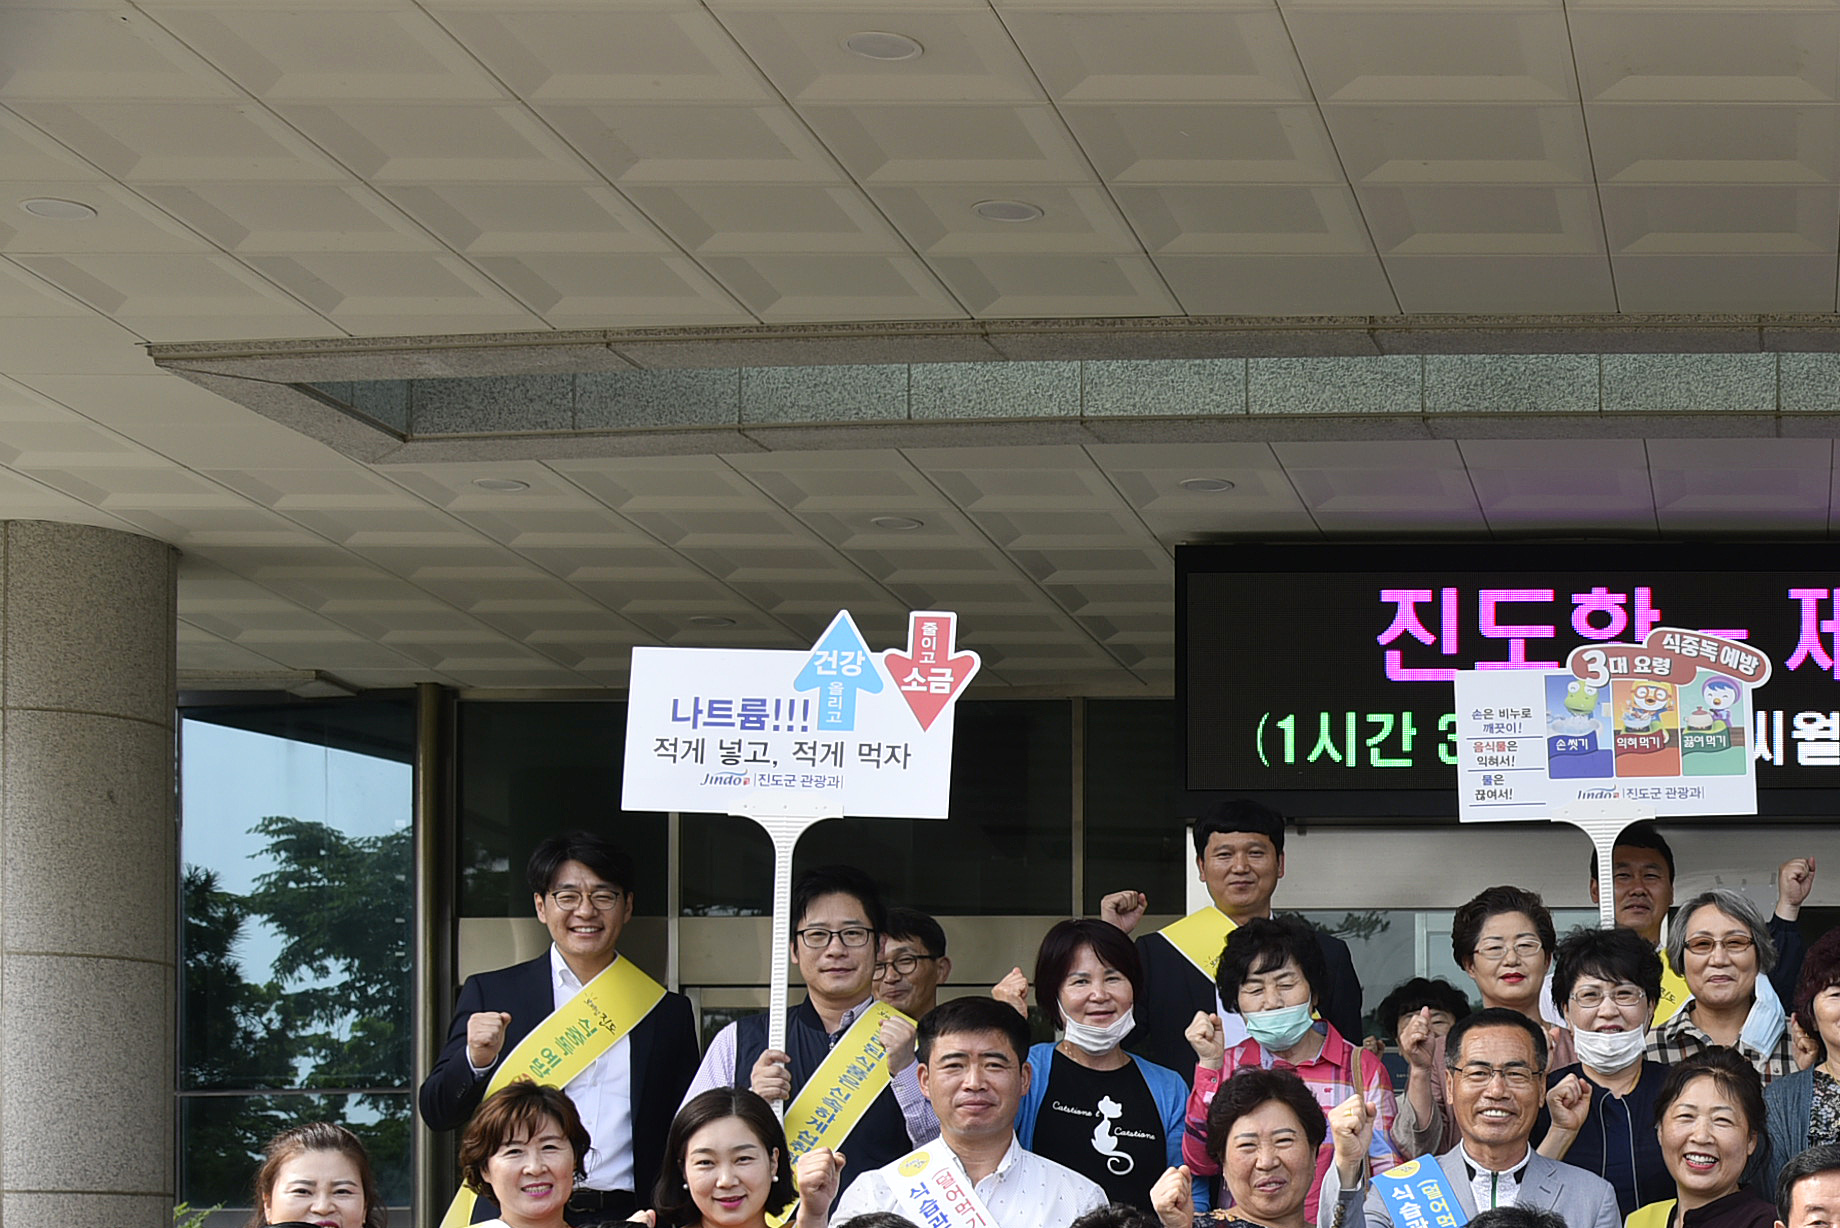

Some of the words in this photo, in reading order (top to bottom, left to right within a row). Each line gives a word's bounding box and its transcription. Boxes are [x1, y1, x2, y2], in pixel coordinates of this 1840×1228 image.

[921, 621, 938, 664] 줄이고
[1662, 633, 1718, 664] 식중독
[1719, 647, 1760, 676] 예방
[813, 651, 866, 676] 건강
[1583, 650, 1628, 687] 3대
[1634, 656, 1672, 674] 요령
[901, 668, 954, 693] 소금
[672, 697, 809, 732] 나트륨!!!
[826, 682, 844, 723] 올리고
[1472, 708, 1494, 720] 손은
[1498, 707, 1532, 720] 비누로
[1482, 722, 1522, 734] 깨끗이!
[654, 737, 705, 764] 적게
[719, 739, 778, 768] 넣고,
[792, 740, 844, 768] 적게
[858, 742, 911, 769] 먹자
[1473, 741, 1518, 753] 음식물은
[758, 774, 796, 788] 진도군
[800, 774, 839, 789] 관광과
[1482, 773, 1504, 786] 물은
[1626, 789, 1662, 799] 진도군
[1666, 788, 1701, 799] 관광과
